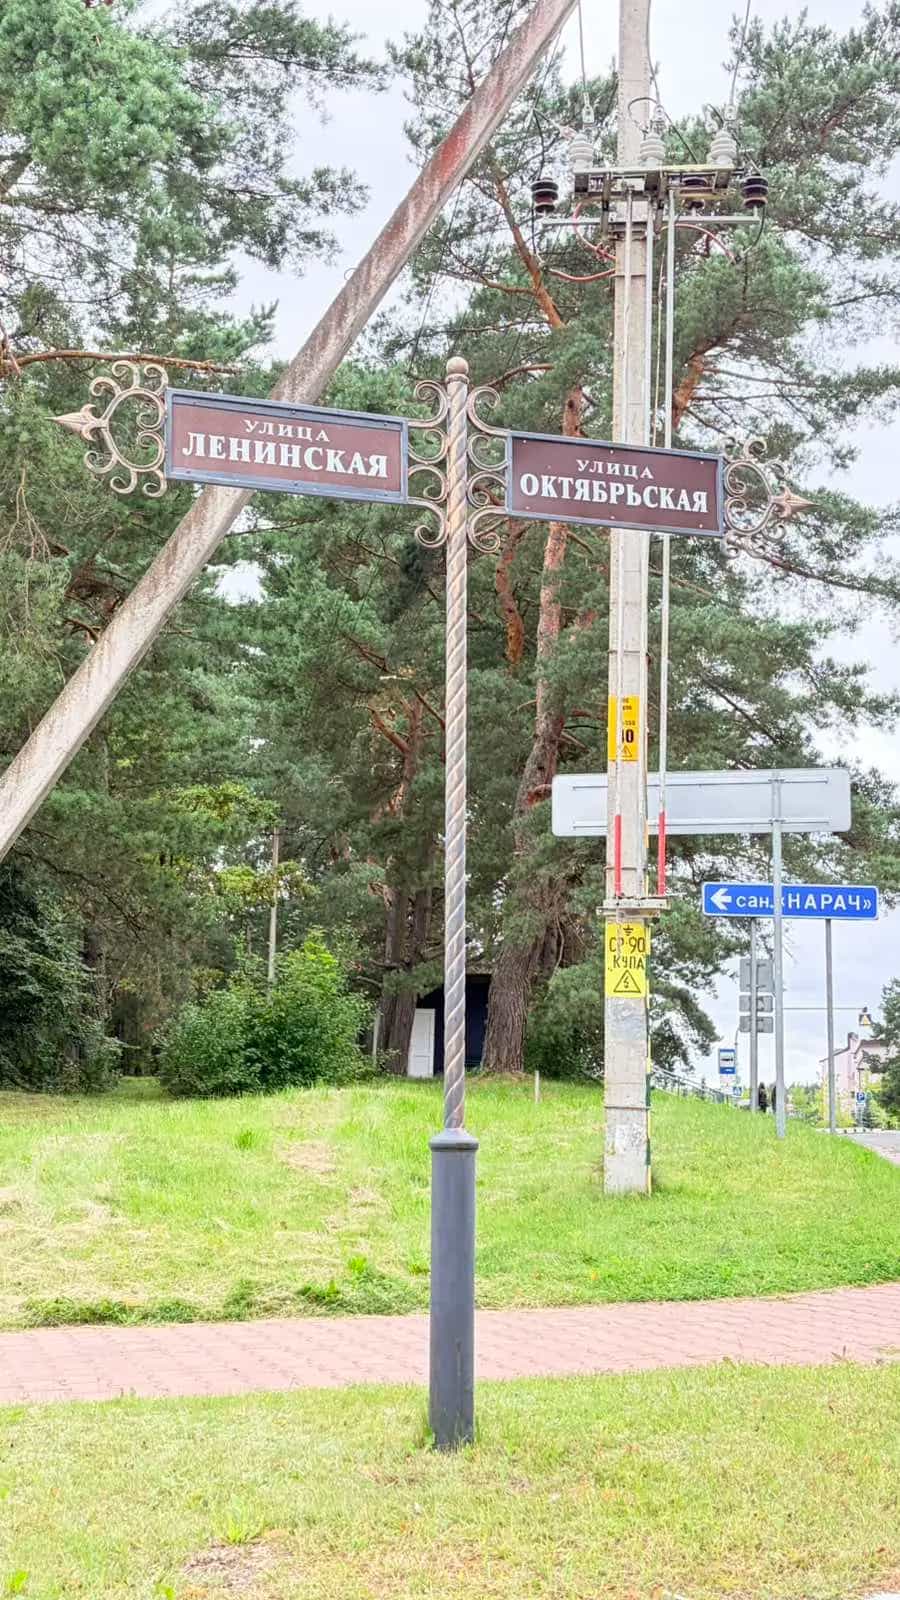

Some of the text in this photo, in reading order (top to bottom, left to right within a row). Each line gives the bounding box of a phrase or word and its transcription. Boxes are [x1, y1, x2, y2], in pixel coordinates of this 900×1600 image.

[243, 419, 330, 442] УЛИЦА
[182, 432, 388, 478] ЛЕНИНСКАЯ
[576, 459, 654, 480] УЛИЦА
[520, 473, 709, 513] ОКТЯБРЬСКАЯ
